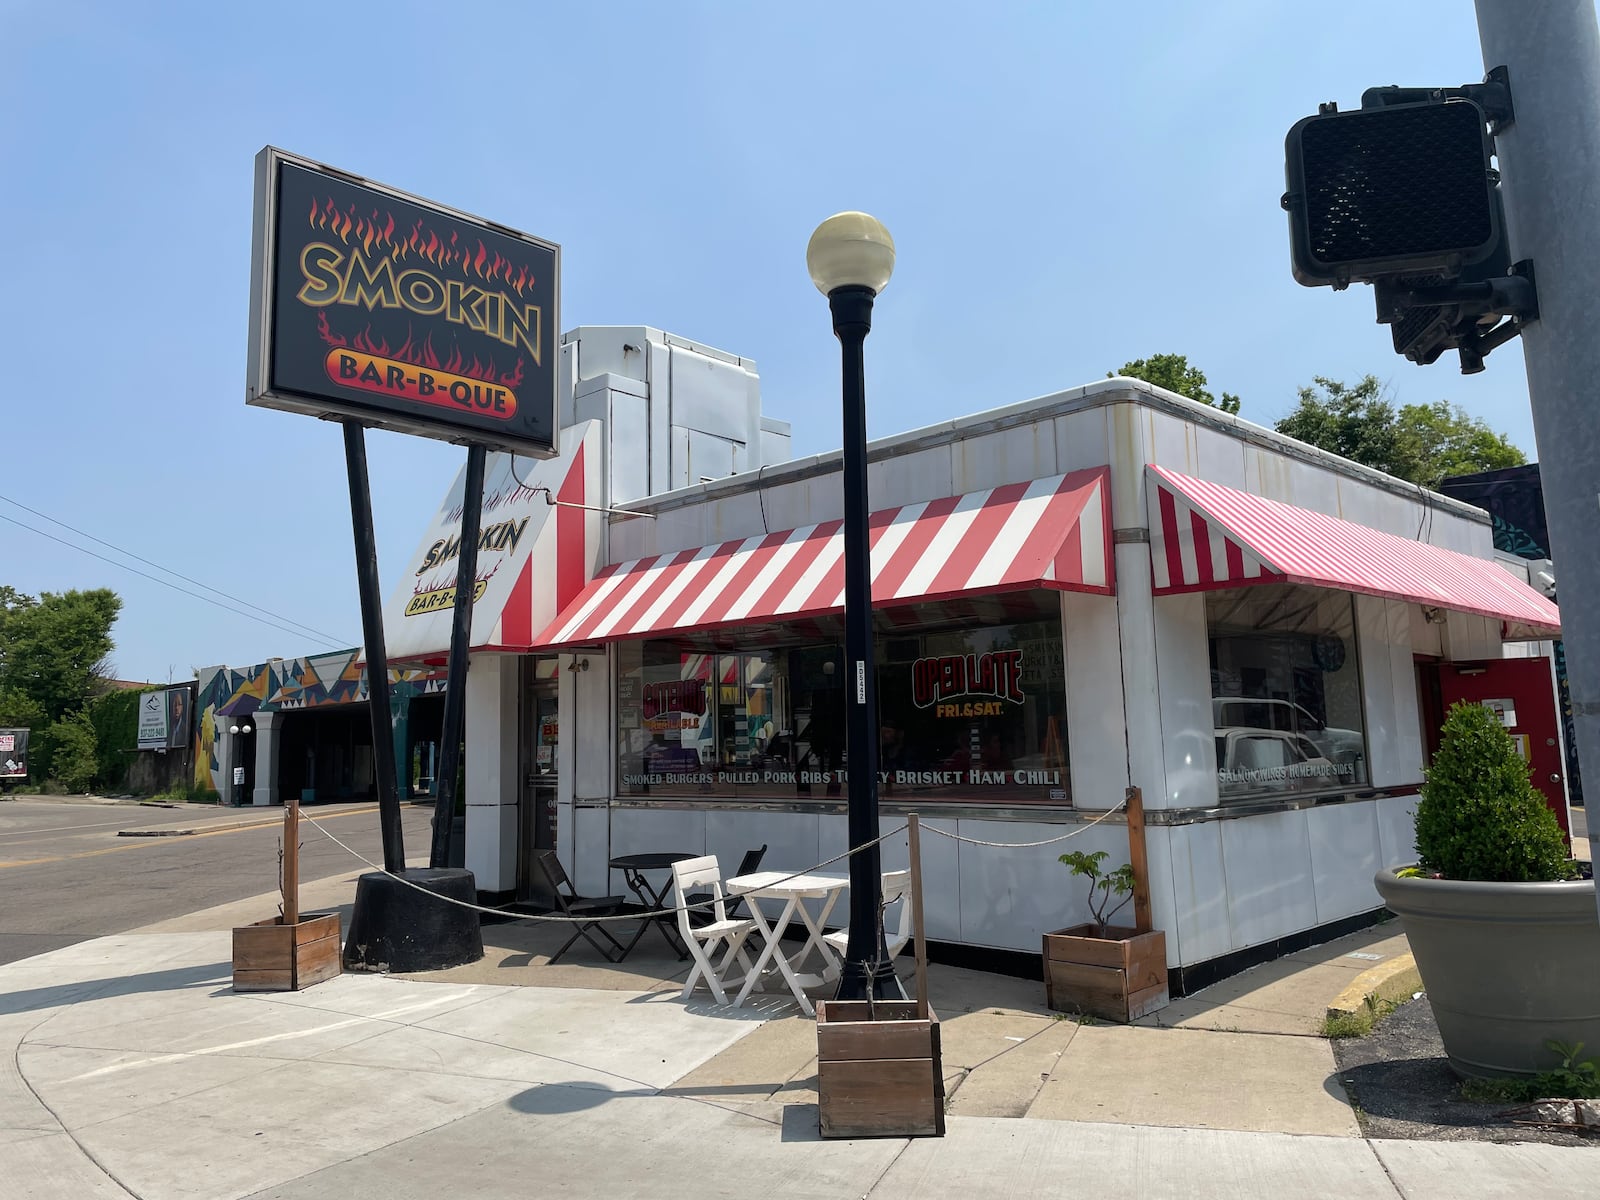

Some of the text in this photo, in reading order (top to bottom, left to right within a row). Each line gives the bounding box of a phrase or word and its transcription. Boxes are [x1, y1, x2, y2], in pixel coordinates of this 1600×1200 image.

[297, 242, 542, 367] SMOKIN
[339, 355, 507, 412] BAR-B-QUE
[415, 515, 530, 577] SMKIN
[912, 655, 967, 708] OPEN
[967, 649, 1025, 704] LATE
[622, 773, 663, 785] SMOKED
[666, 772, 713, 785] BURGERS
[718, 771, 759, 784] PULLED
[764, 770, 797, 784] PORK
[801, 770, 831, 784] RIBS
[895, 769, 963, 785] BRISKET
[969, 769, 1005, 785] HAM
[1013, 769, 1060, 785] CHILI
[1289, 764, 1331, 778] HOMEMADE
[1332, 763, 1354, 775] SIDES
